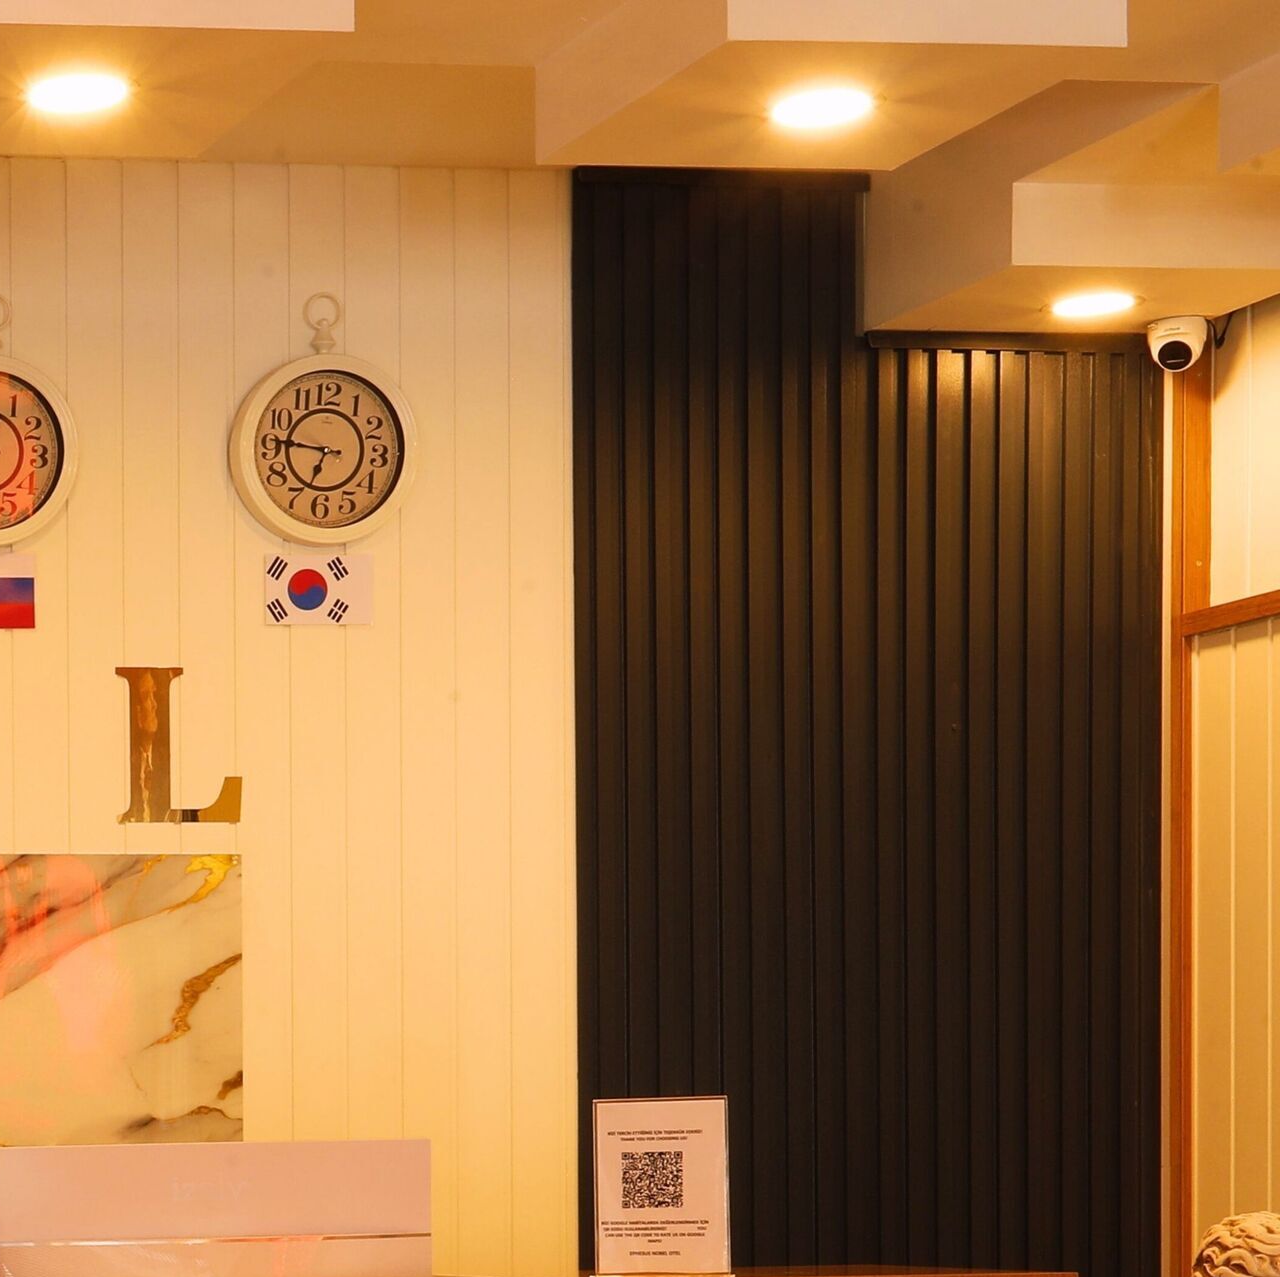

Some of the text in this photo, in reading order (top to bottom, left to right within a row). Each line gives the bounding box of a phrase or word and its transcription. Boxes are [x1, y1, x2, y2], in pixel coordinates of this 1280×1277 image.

[9, 394, 18, 418] 1
[293, 387, 311, 411] 11
[315, 381, 342, 407] 12
[351, 393, 360, 417] 1
[24, 415, 43, 441] 2
[270, 407, 293, 431] 10
[365, 415, 384, 441] 2
[29, 444, 49, 469] 3
[260, 433, 282, 461] 9
[369, 444, 389, 469] 3
[15, 469, 39, 496] 4
[266, 462, 288, 488] 8
[355, 469, 379, 494] 4
[0, 492, 18, 517] 5
[287, 486, 306, 510] 7
[310, 493, 330, 520] 6
[338, 490, 357, 515] 5
